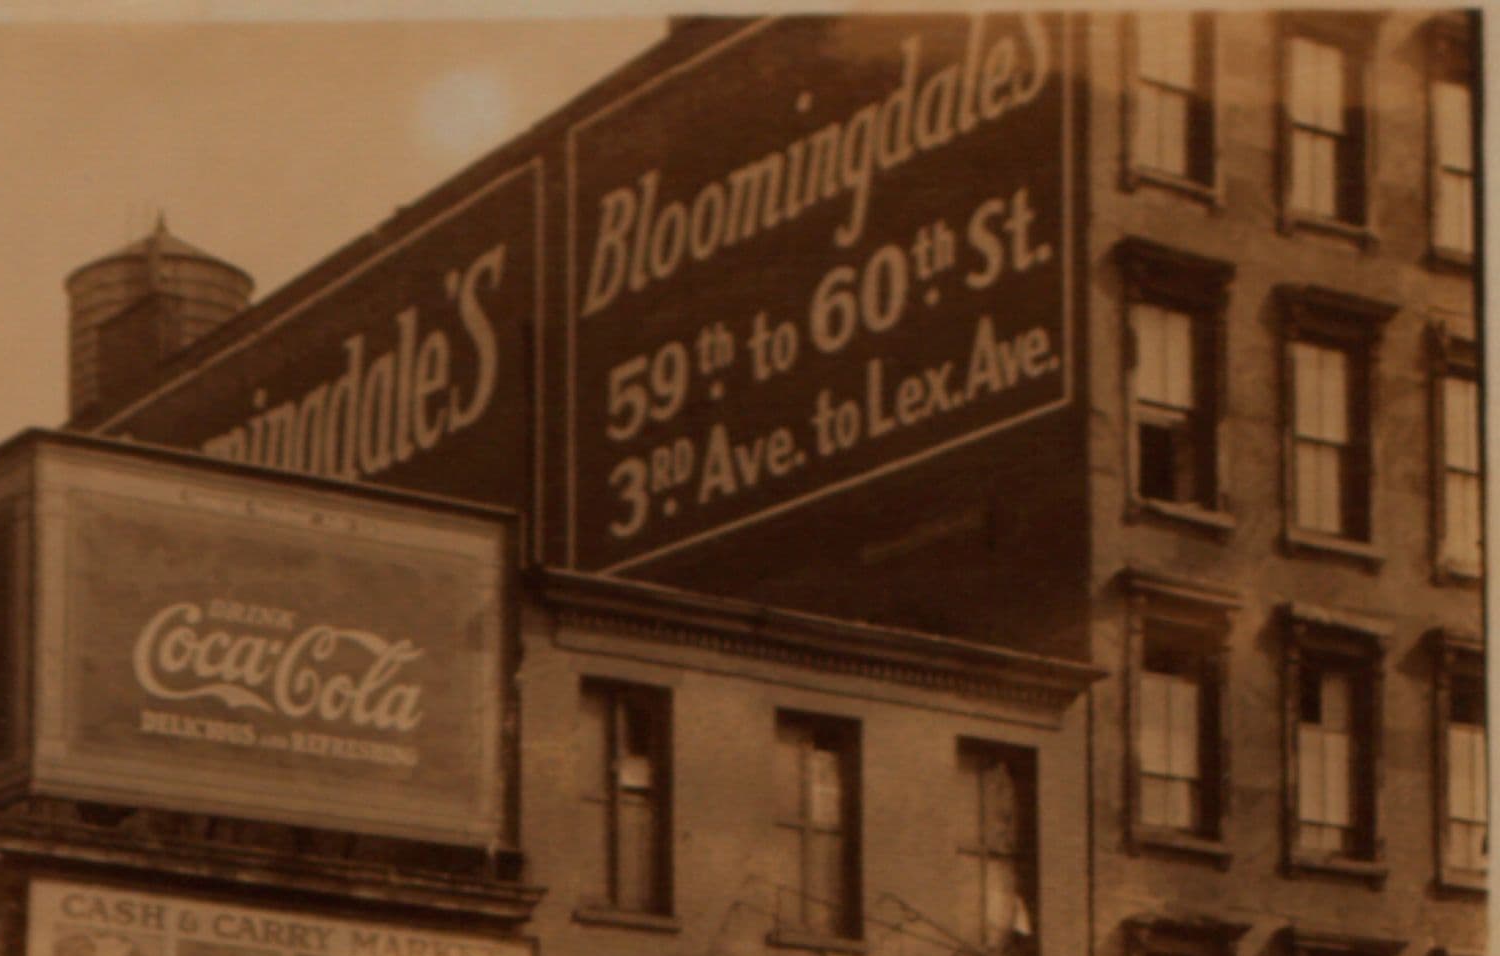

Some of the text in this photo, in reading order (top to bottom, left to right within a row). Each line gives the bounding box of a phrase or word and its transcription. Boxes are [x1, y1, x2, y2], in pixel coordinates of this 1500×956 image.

[606, 186, 1052, 442] 59th to 60th St.
[699, 423, 808, 505] Ave.
[811, 388, 862, 457] to
[866, 356, 965, 439] Lex.
[966, 314, 1060, 401] Ave.
[132, 602, 426, 732] Coca-Cola
[61, 893, 166, 932] CASH
[176, 909, 199, 935] &
[211, 913, 336, 952] CARRY
